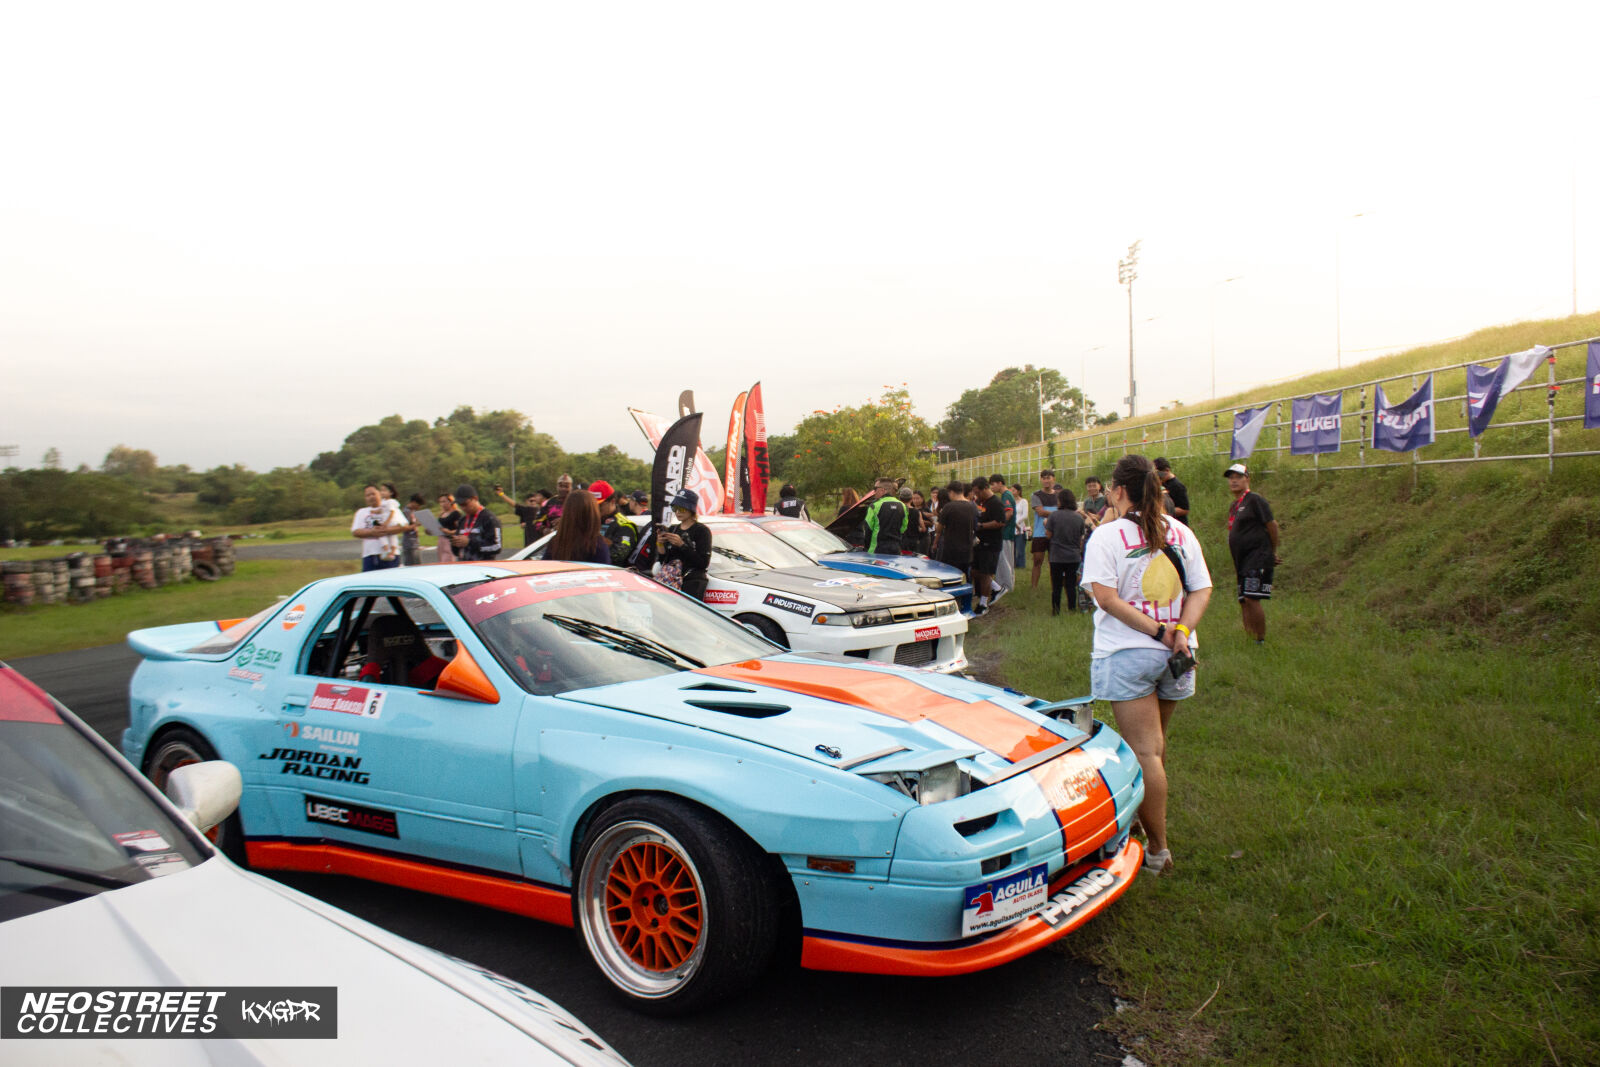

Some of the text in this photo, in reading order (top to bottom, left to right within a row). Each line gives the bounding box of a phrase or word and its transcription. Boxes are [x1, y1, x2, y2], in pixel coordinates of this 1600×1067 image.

[774, 597, 813, 614] INDUSTRIES
[369, 700, 378, 715] 6
[302, 725, 359, 746] SAILUN
[258, 748, 362, 769] JORDAN
[282, 762, 371, 784] RACING
[995, 874, 1044, 902] AGUILA
[1013, 894, 1026, 904] AUTO
